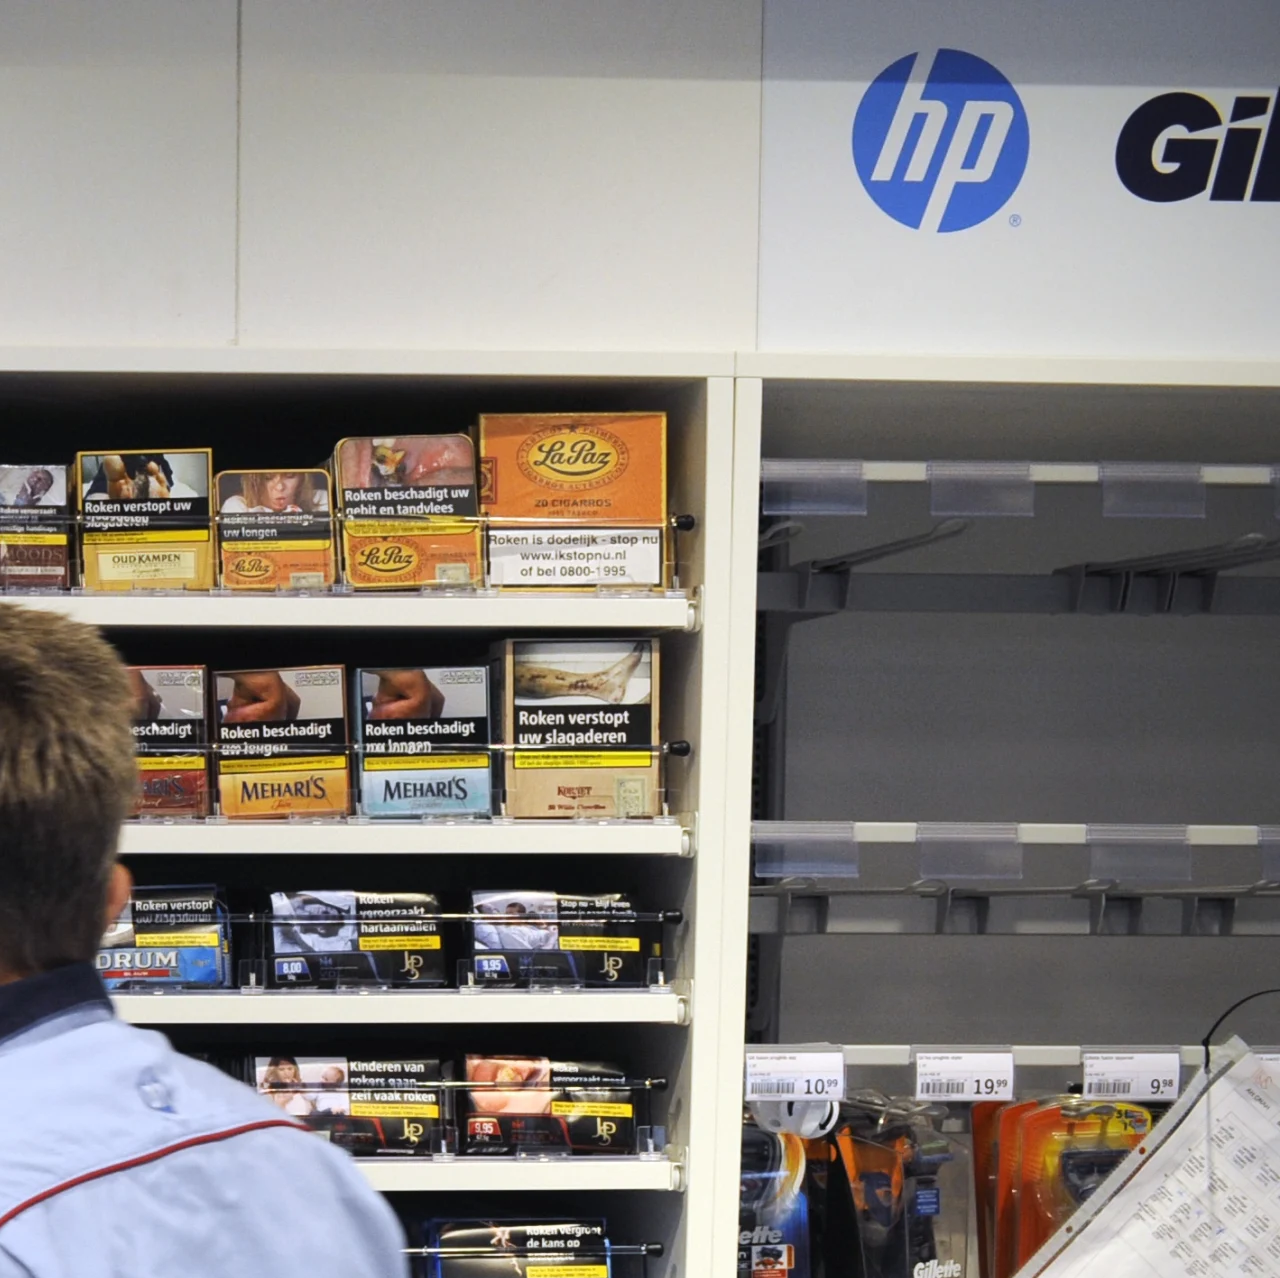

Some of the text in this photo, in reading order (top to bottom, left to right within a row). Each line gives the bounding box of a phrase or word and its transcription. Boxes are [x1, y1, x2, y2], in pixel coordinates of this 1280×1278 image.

[871, 49, 1014, 232] hp
[533, 439, 612, 466] La Paz
[345, 487, 470, 503] Roken beschadigt uw
[534, 499, 612, 508] 20 CIGARROS
[85, 500, 192, 514] Roken verstopt uw
[490, 534, 659, 549] Roken is dodelijk stop nu
[112, 553, 181, 565] OUD KAMPEN
[358, 547, 416, 567] La Paz
[520, 550, 627, 564] www.ikstopnu.nl
[521, 565, 627, 578] of bel 0800-1995
[519, 709, 630, 727] Roken verstopt
[221, 723, 332, 740] Roken beschadigt
[519, 729, 627, 746] uw slagaderen
[241, 776, 327, 803] MEHARI'S
[383, 777, 468, 802] MEHARI'S
[135, 899, 214, 913] Roken verstopt
[95, 952, 178, 970] DRUM
[350, 1061, 425, 1073] Kinderen van
[804, 1078, 838, 1095] 10.99
[974, 1078, 1008, 1095] 19.99
[1151, 1078, 1173, 1095] 9.98
